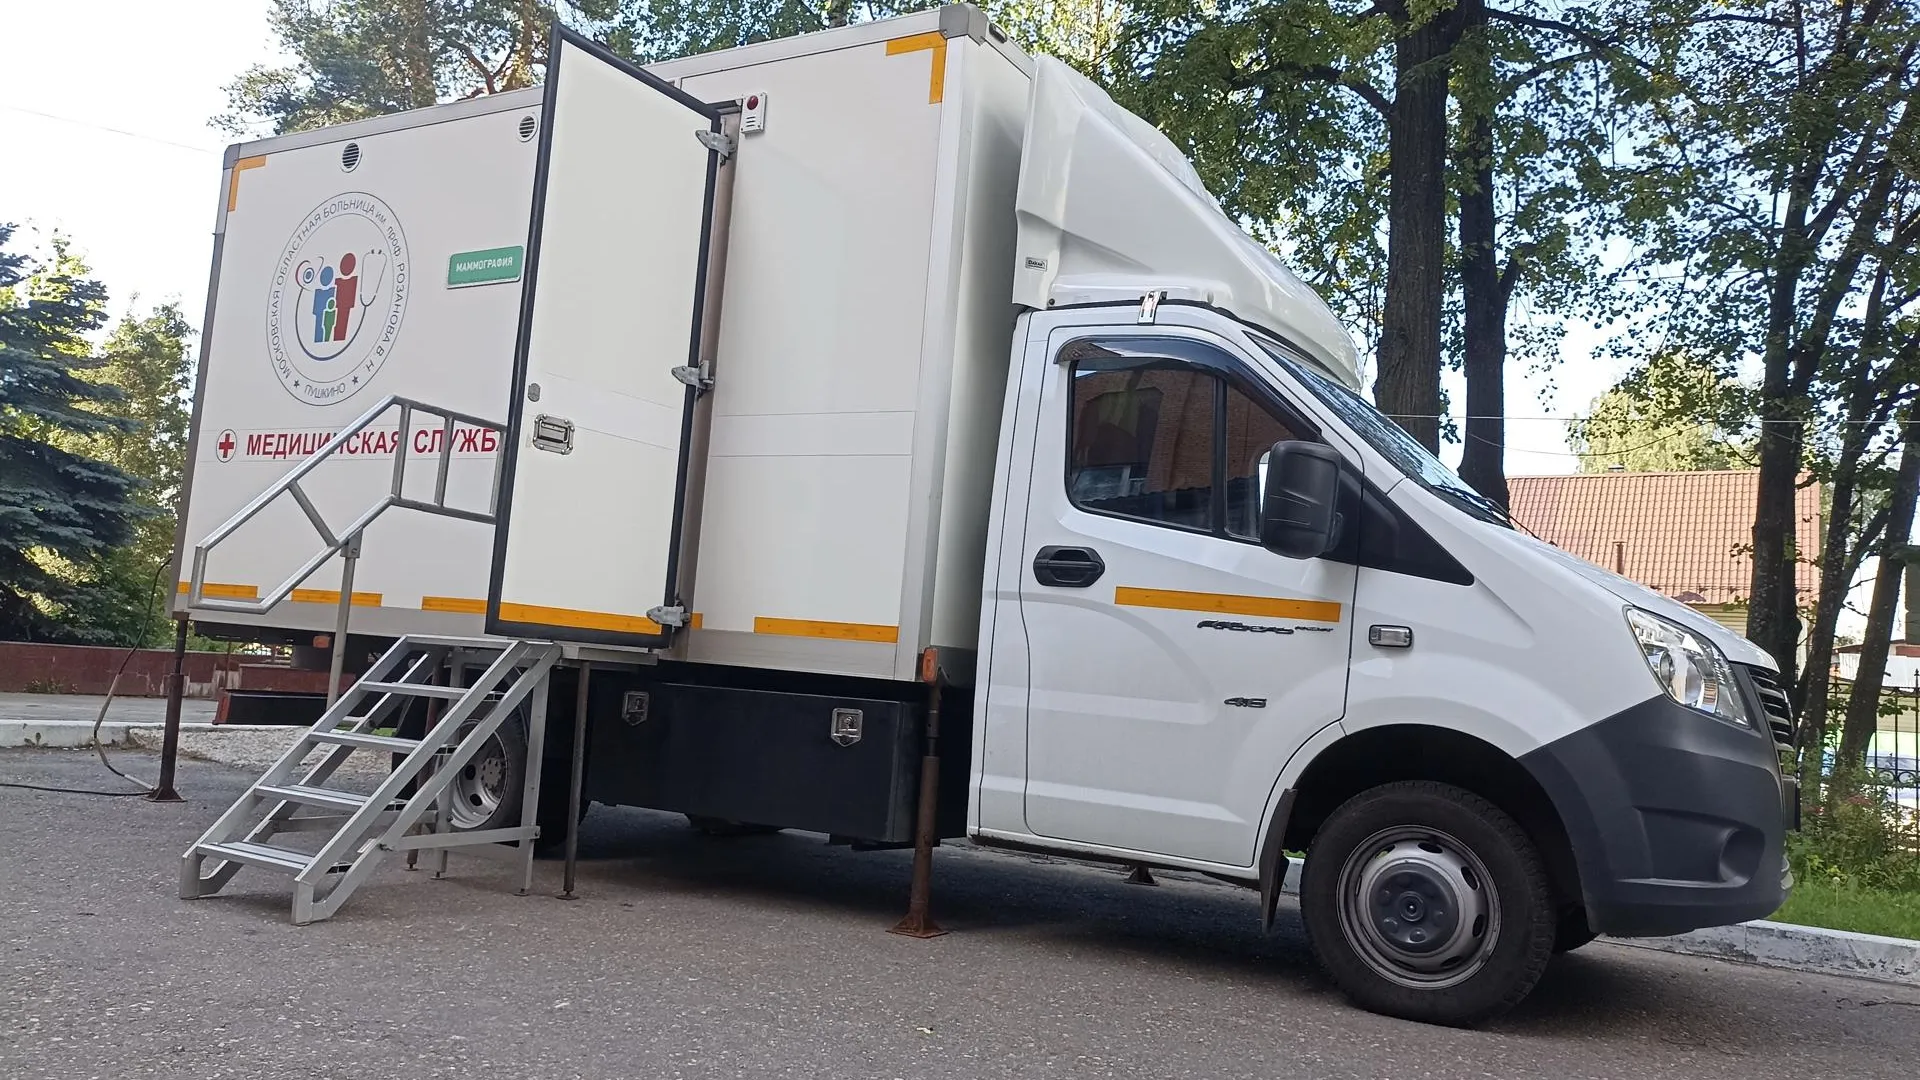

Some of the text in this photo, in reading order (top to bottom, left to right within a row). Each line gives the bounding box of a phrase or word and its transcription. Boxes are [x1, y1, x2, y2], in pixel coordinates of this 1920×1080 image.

[323, 199, 376, 218] БОЛЬНИЦА
[276, 213, 322, 286] ОБЛАСТНАЯ
[455, 256, 514, 273] МАММОГРАФИЯ
[382, 263, 405, 342] РОЗАНОВА
[270, 290, 293, 379] МОСКОВСКАЯ
[304, 382, 346, 399] ПУШКИНО
[413, 428, 500, 454] СЛУЖБ
